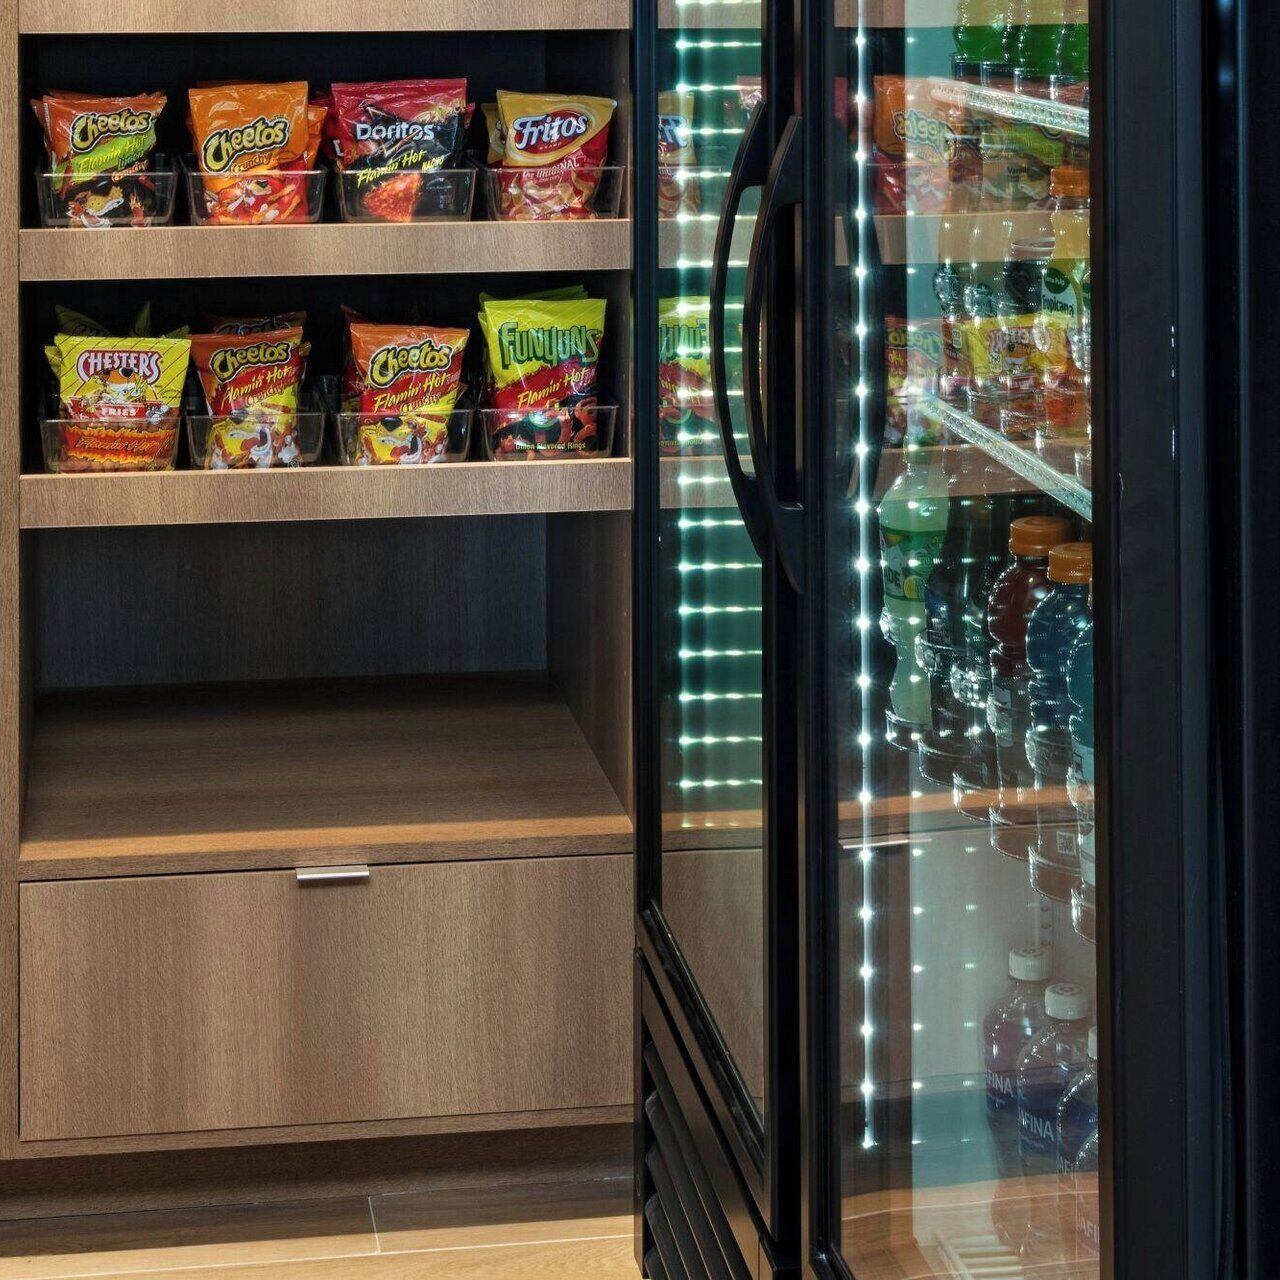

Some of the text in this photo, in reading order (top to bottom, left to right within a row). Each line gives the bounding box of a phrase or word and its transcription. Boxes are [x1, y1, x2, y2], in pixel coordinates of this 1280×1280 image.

[72, 109, 151, 150] Cheetos
[123, 135, 147, 153] Hot
[206, 120, 287, 171] Cheetos
[356, 122, 436, 141] Doritos
[513, 113, 589, 151] Fritos
[231, 151, 271, 174] Crunchy
[357, 149, 427, 189] Flamin' Hot
[421, 156, 446, 171] NACHO
[536, 157, 580, 178] ORIGINAL
[77, 351, 160, 385] CHESTER'S
[212, 341, 289, 382] Cheetos
[372, 341, 452, 387] Cheetos
[221, 365, 292, 411] Flamin' Hot
[374, 372, 449, 415] Flamin' Hot
[517, 378, 563, 410] Flamin'
[101, 408, 137, 416] FRIES
